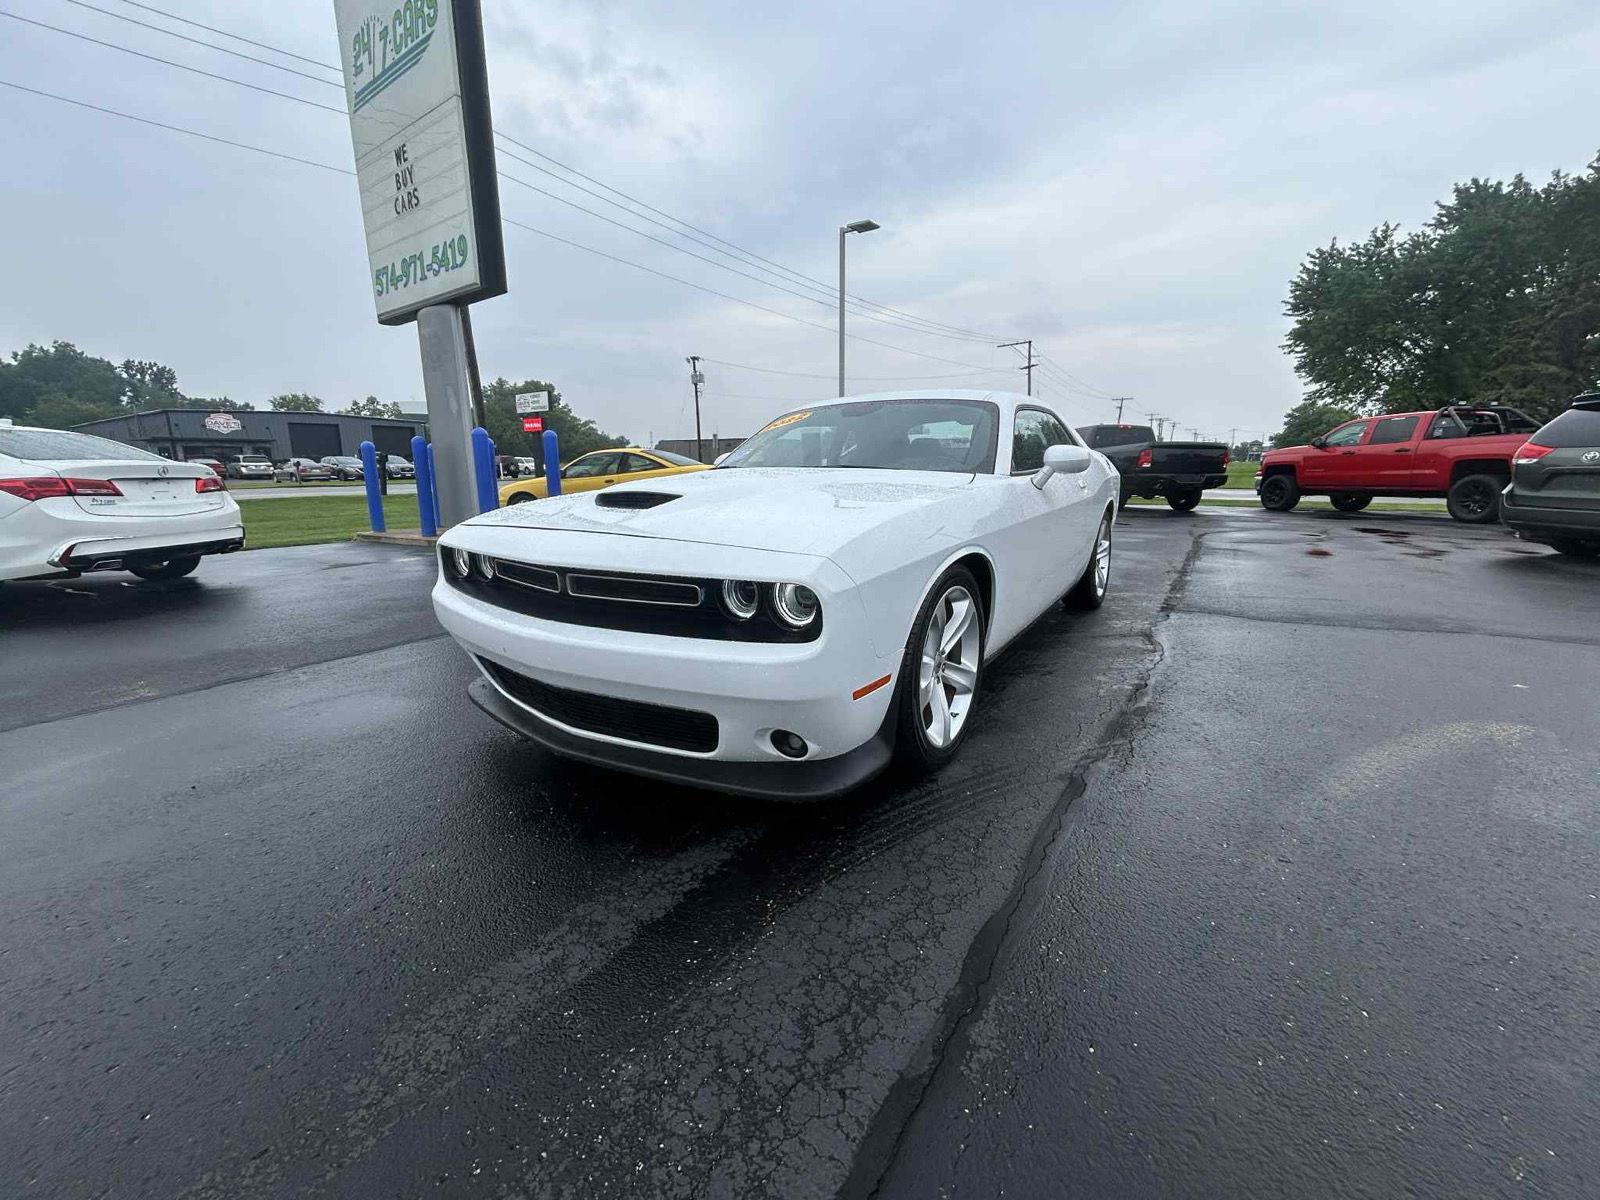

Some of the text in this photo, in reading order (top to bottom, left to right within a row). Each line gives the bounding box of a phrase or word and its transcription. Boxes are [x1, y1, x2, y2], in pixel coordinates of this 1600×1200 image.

[394, 143, 408, 167] WE
[395, 164, 413, 191] BUY
[394, 187, 420, 215] CARS
[375, 233, 468, 297] 574-971-5419
